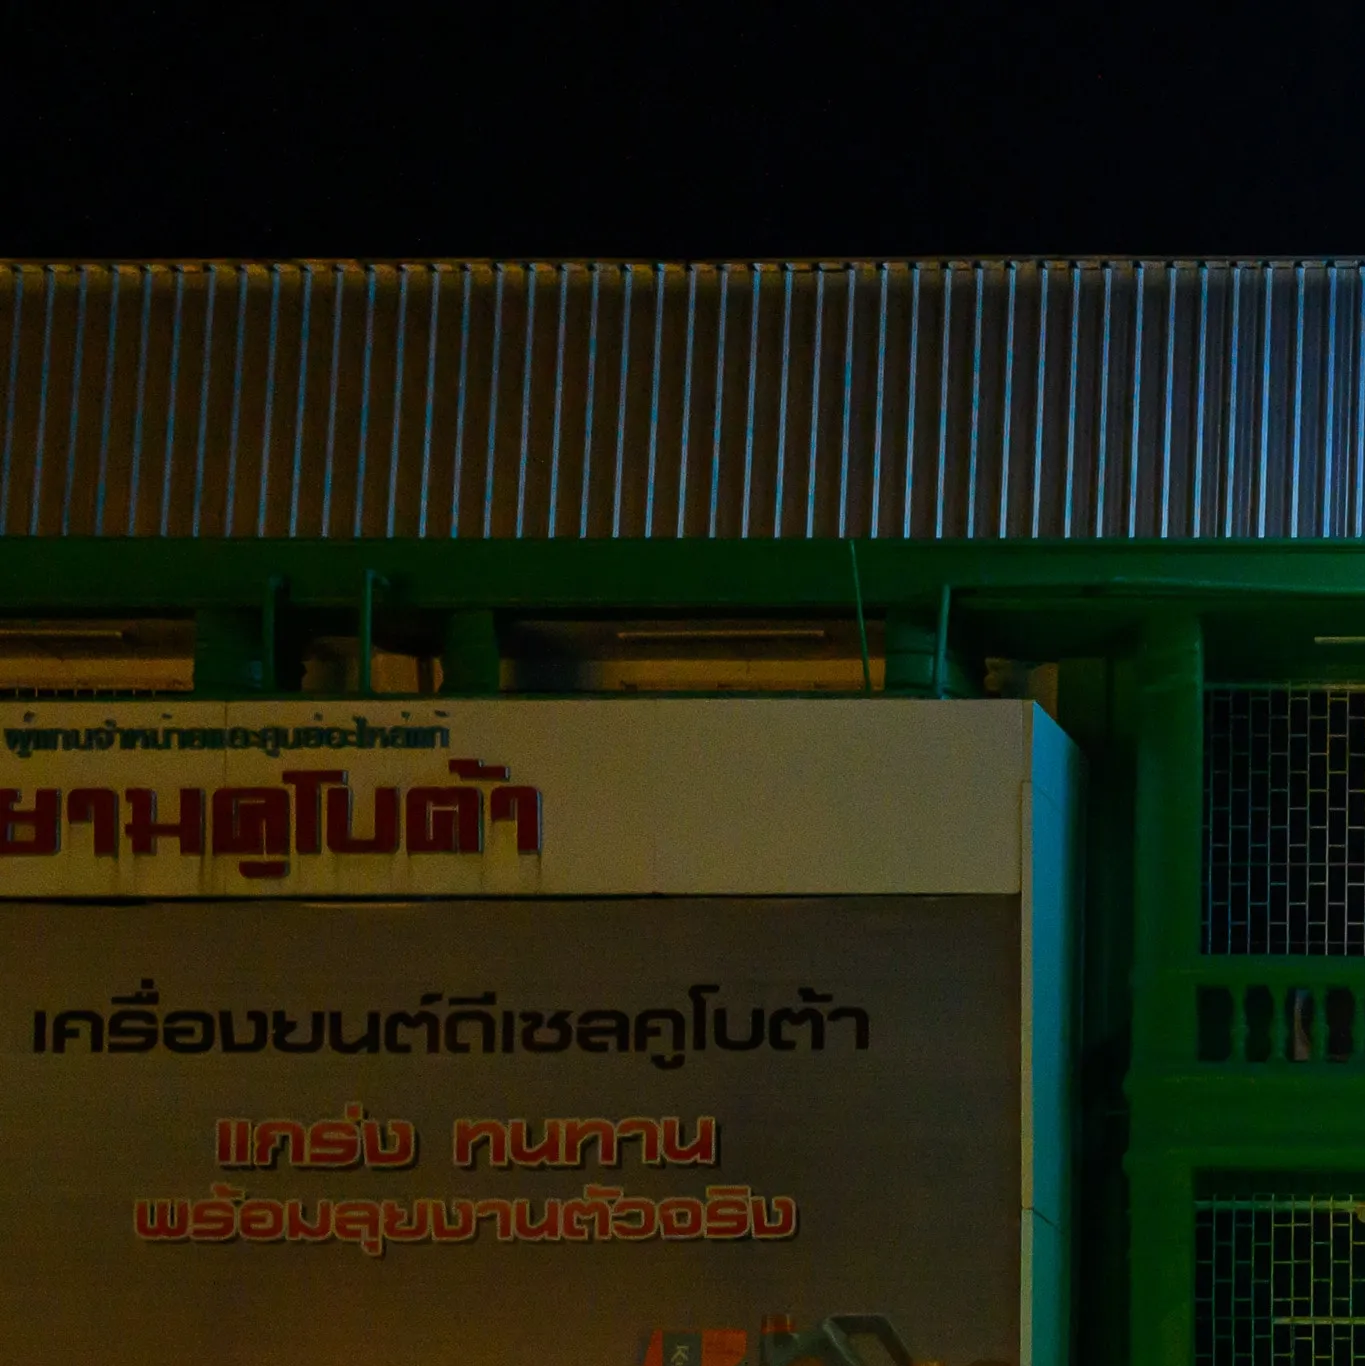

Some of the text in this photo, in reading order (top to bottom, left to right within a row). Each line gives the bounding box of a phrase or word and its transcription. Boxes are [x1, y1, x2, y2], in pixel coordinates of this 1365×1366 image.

[33, 978, 870, 1069] เครื่องยนต์ดีเซลคูโบต้า
[214, 1102, 719, 1170] แกร่ง ทนทาน
[134, 1183, 799, 1258] พร้อมลุยงานตัวจริง
